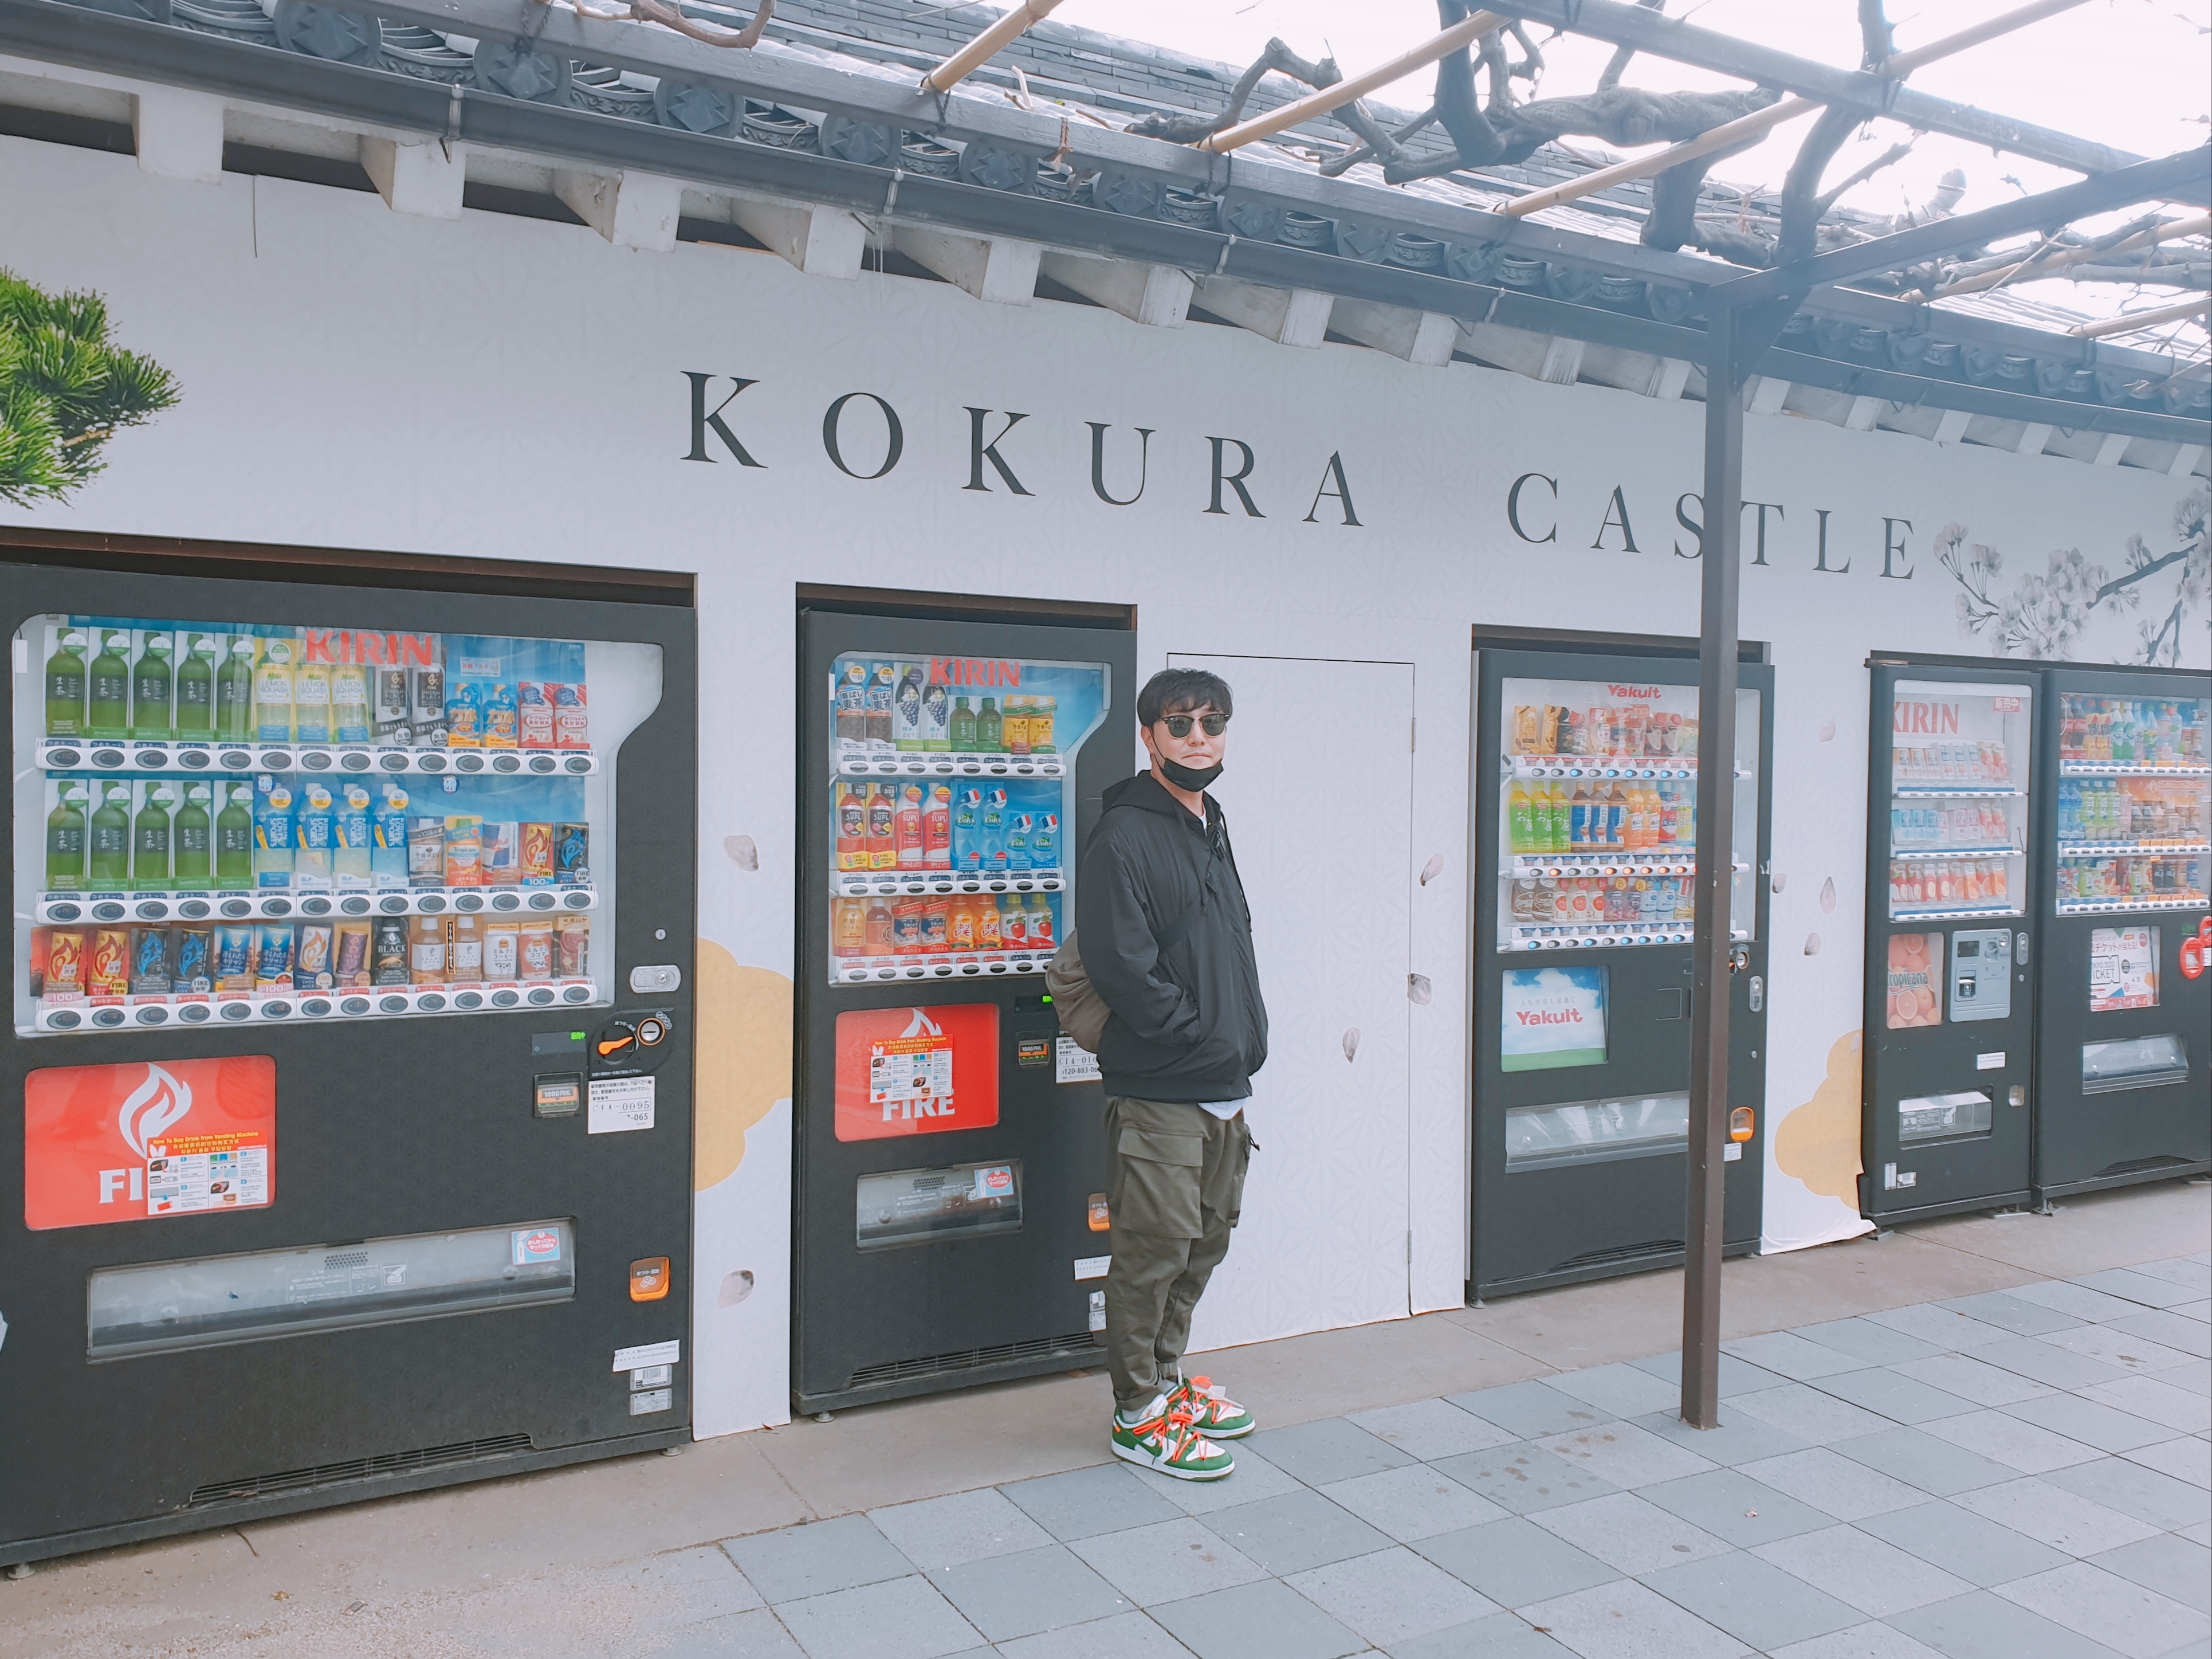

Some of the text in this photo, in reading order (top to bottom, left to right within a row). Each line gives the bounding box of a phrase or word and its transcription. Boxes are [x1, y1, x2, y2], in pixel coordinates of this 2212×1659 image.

[680, 370, 1915, 580] KOKURA CASTLE
[306, 629, 433, 666] KIRIN
[930, 657, 1019, 687] KIRIN
[1607, 684, 1662, 699] Yakult
[1995, 697, 2019, 709] 販売中
[58, 829, 68, 849] 生茶
[100, 829, 109, 849] 生茶
[145, 829, 155, 849] 生茶
[184, 828, 193, 848] 生茶
[226, 829, 235, 849] 生茶
[1888, 967, 1928, 989] ropicana
[2093, 968, 2115, 980] ICKET
[1516, 1008, 1584, 1026] Yakult
[882, 1091, 955, 1121] FIRE
[99, 1167, 143, 1203] FI
